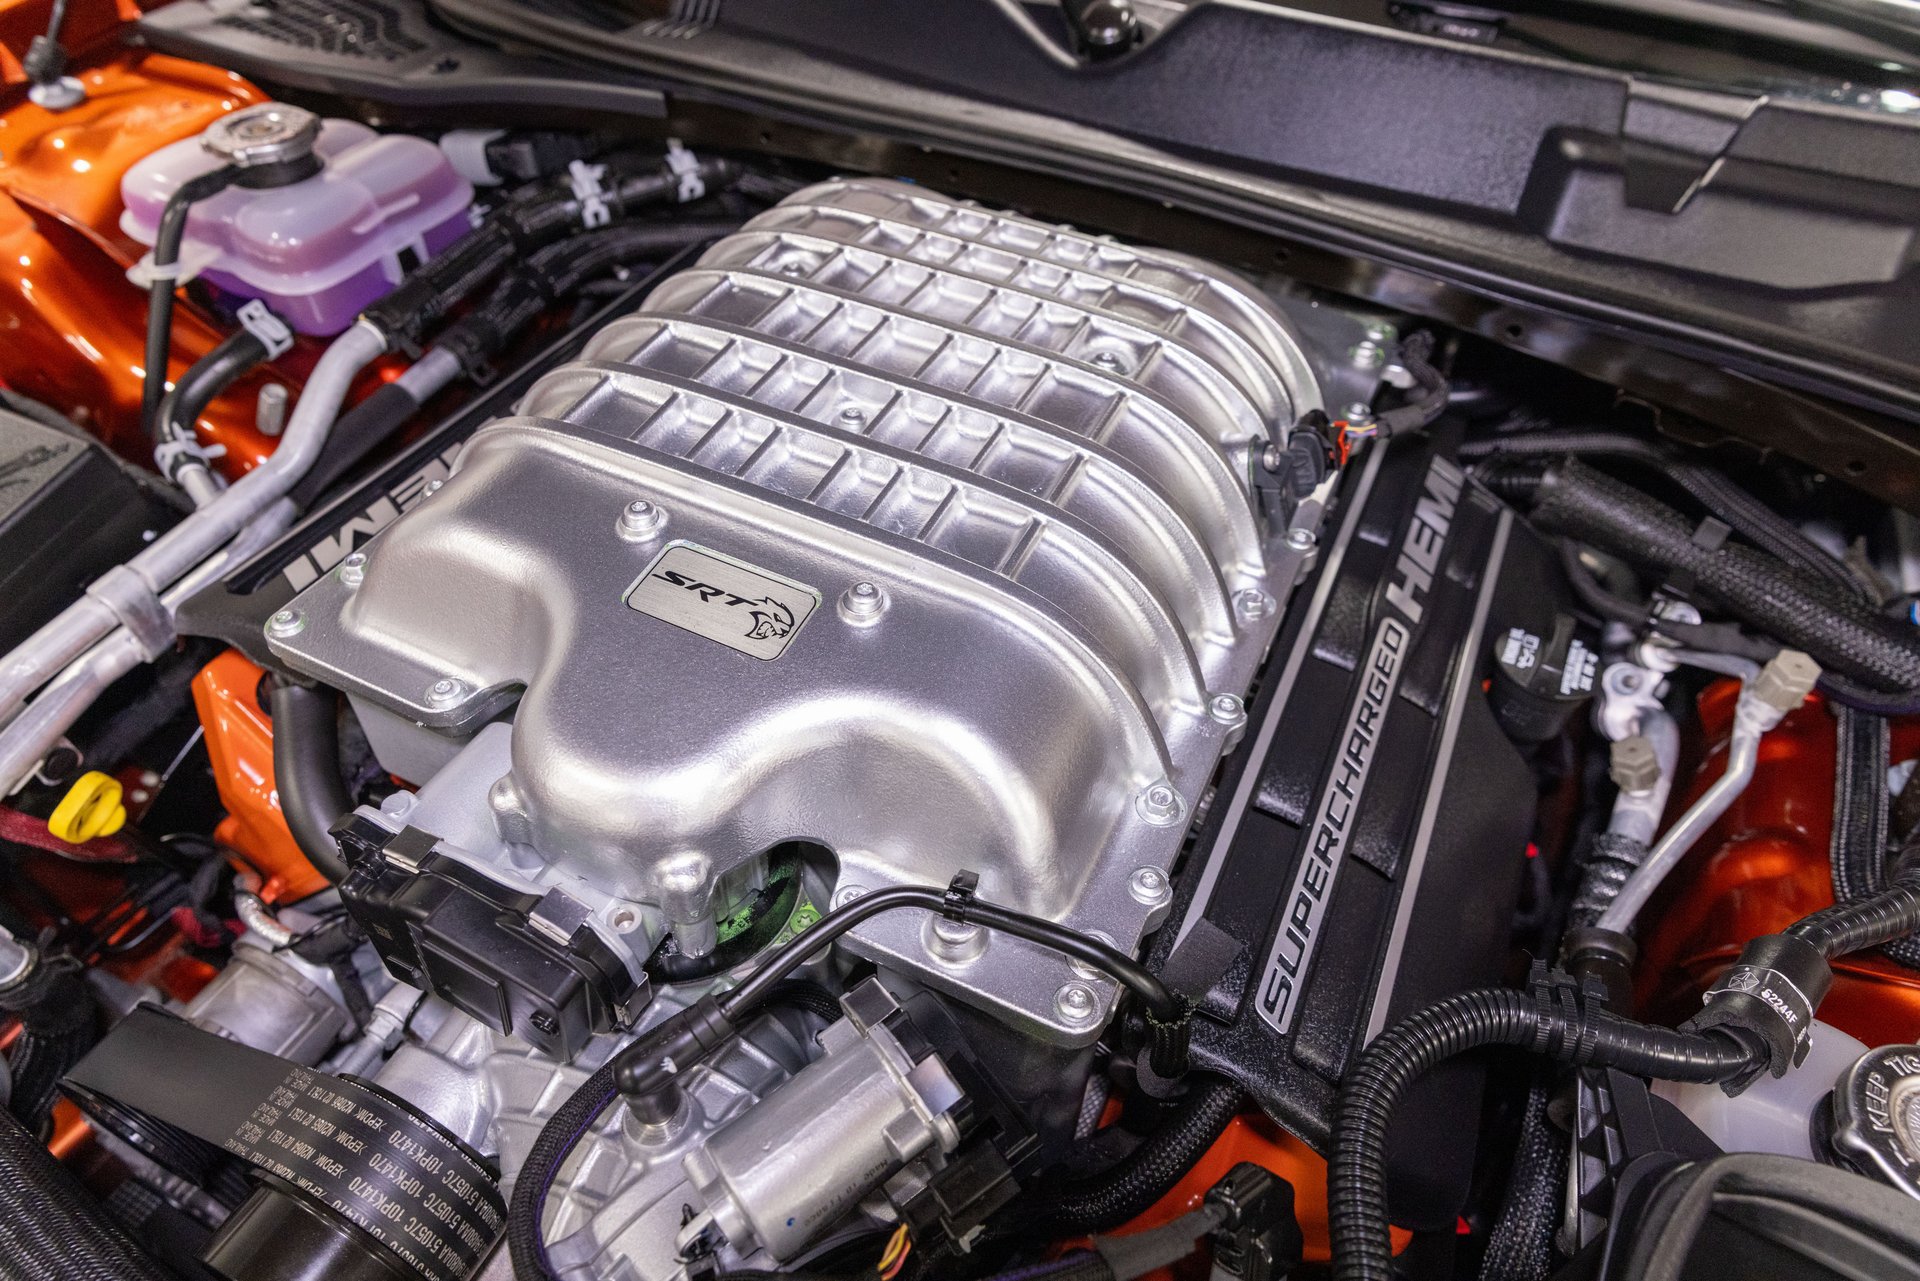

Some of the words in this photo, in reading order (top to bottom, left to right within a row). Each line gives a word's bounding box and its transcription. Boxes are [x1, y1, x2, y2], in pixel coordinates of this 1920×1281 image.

[652, 570, 759, 608] SRT
[1263, 616, 1406, 1029] SUPERCHARGED
[1386, 453, 1465, 624] HEMI
[1761, 988, 1798, 1024] 62244F
[1866, 1072, 1894, 1133] KEEP
[387, 1128, 444, 1174] 10PK1470
[862, 1158, 888, 1181] Made
[367, 1151, 426, 1198] 10PK1470
[441, 1168, 481, 1204] 51057C
[347, 1175, 407, 1222] 10PK1470
[422, 1192, 462, 1227] 51057C
[403, 1216, 443, 1252] 51057C
